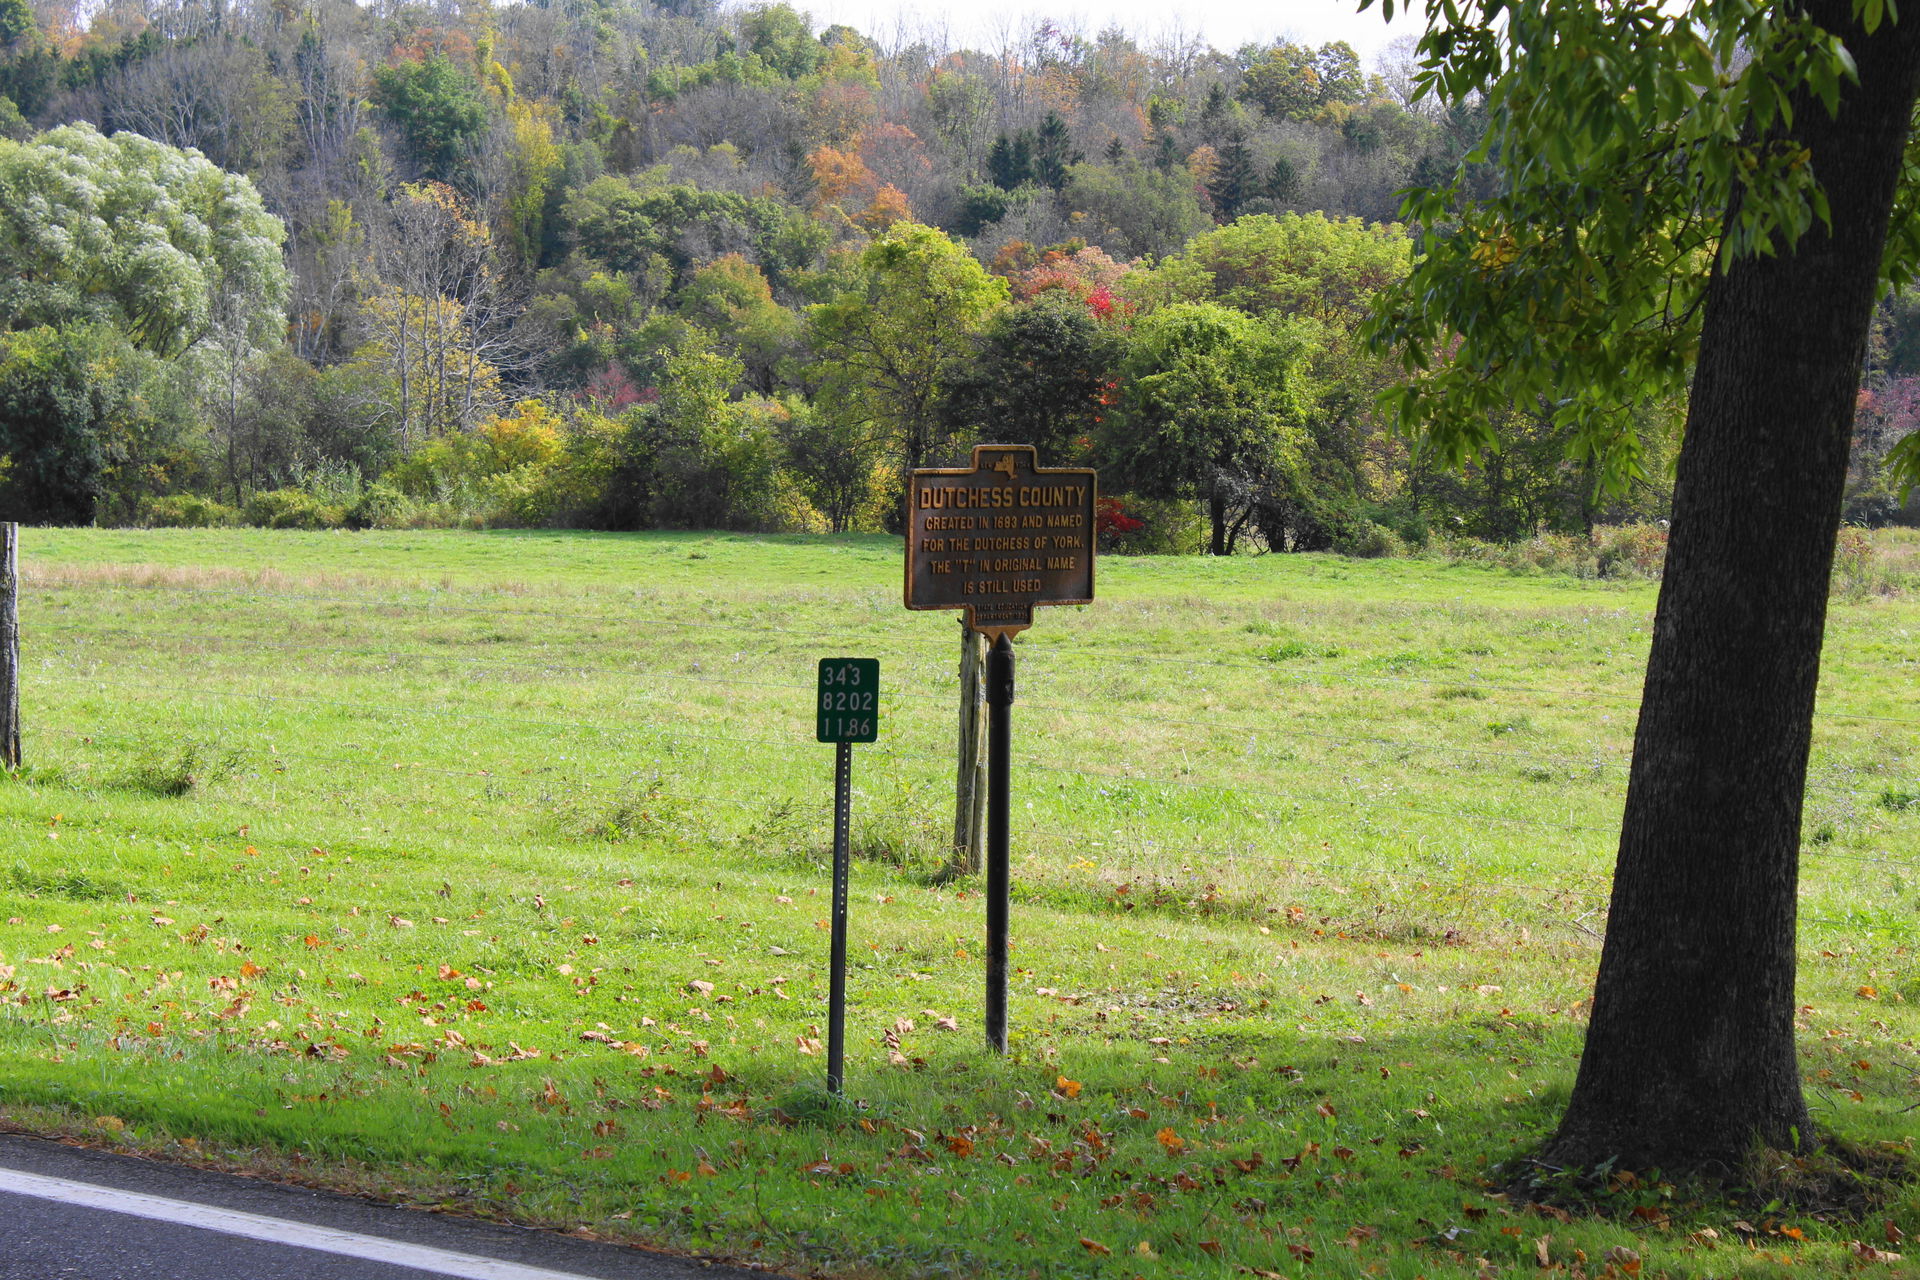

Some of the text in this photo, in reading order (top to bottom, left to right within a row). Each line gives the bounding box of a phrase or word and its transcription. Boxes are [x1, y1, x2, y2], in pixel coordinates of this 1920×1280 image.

[921, 486, 1085, 508] DUTCHESS COUNTY
[926, 514, 1082, 530] CREATED IN 1683 AND NAMED
[923, 535, 1084, 552] FOR THE DUTCHESS OF YORK.
[931, 560, 951, 574] THE
[980, 559, 990, 572] IN
[994, 558, 1041, 571] ORIGINAL
[1047, 556, 1075, 569] NAME
[964, 579, 1041, 594] IS STILL USED
[824, 667, 860, 686] 343
[823, 692, 873, 711] 8202
[824, 718, 870, 736] 1186
